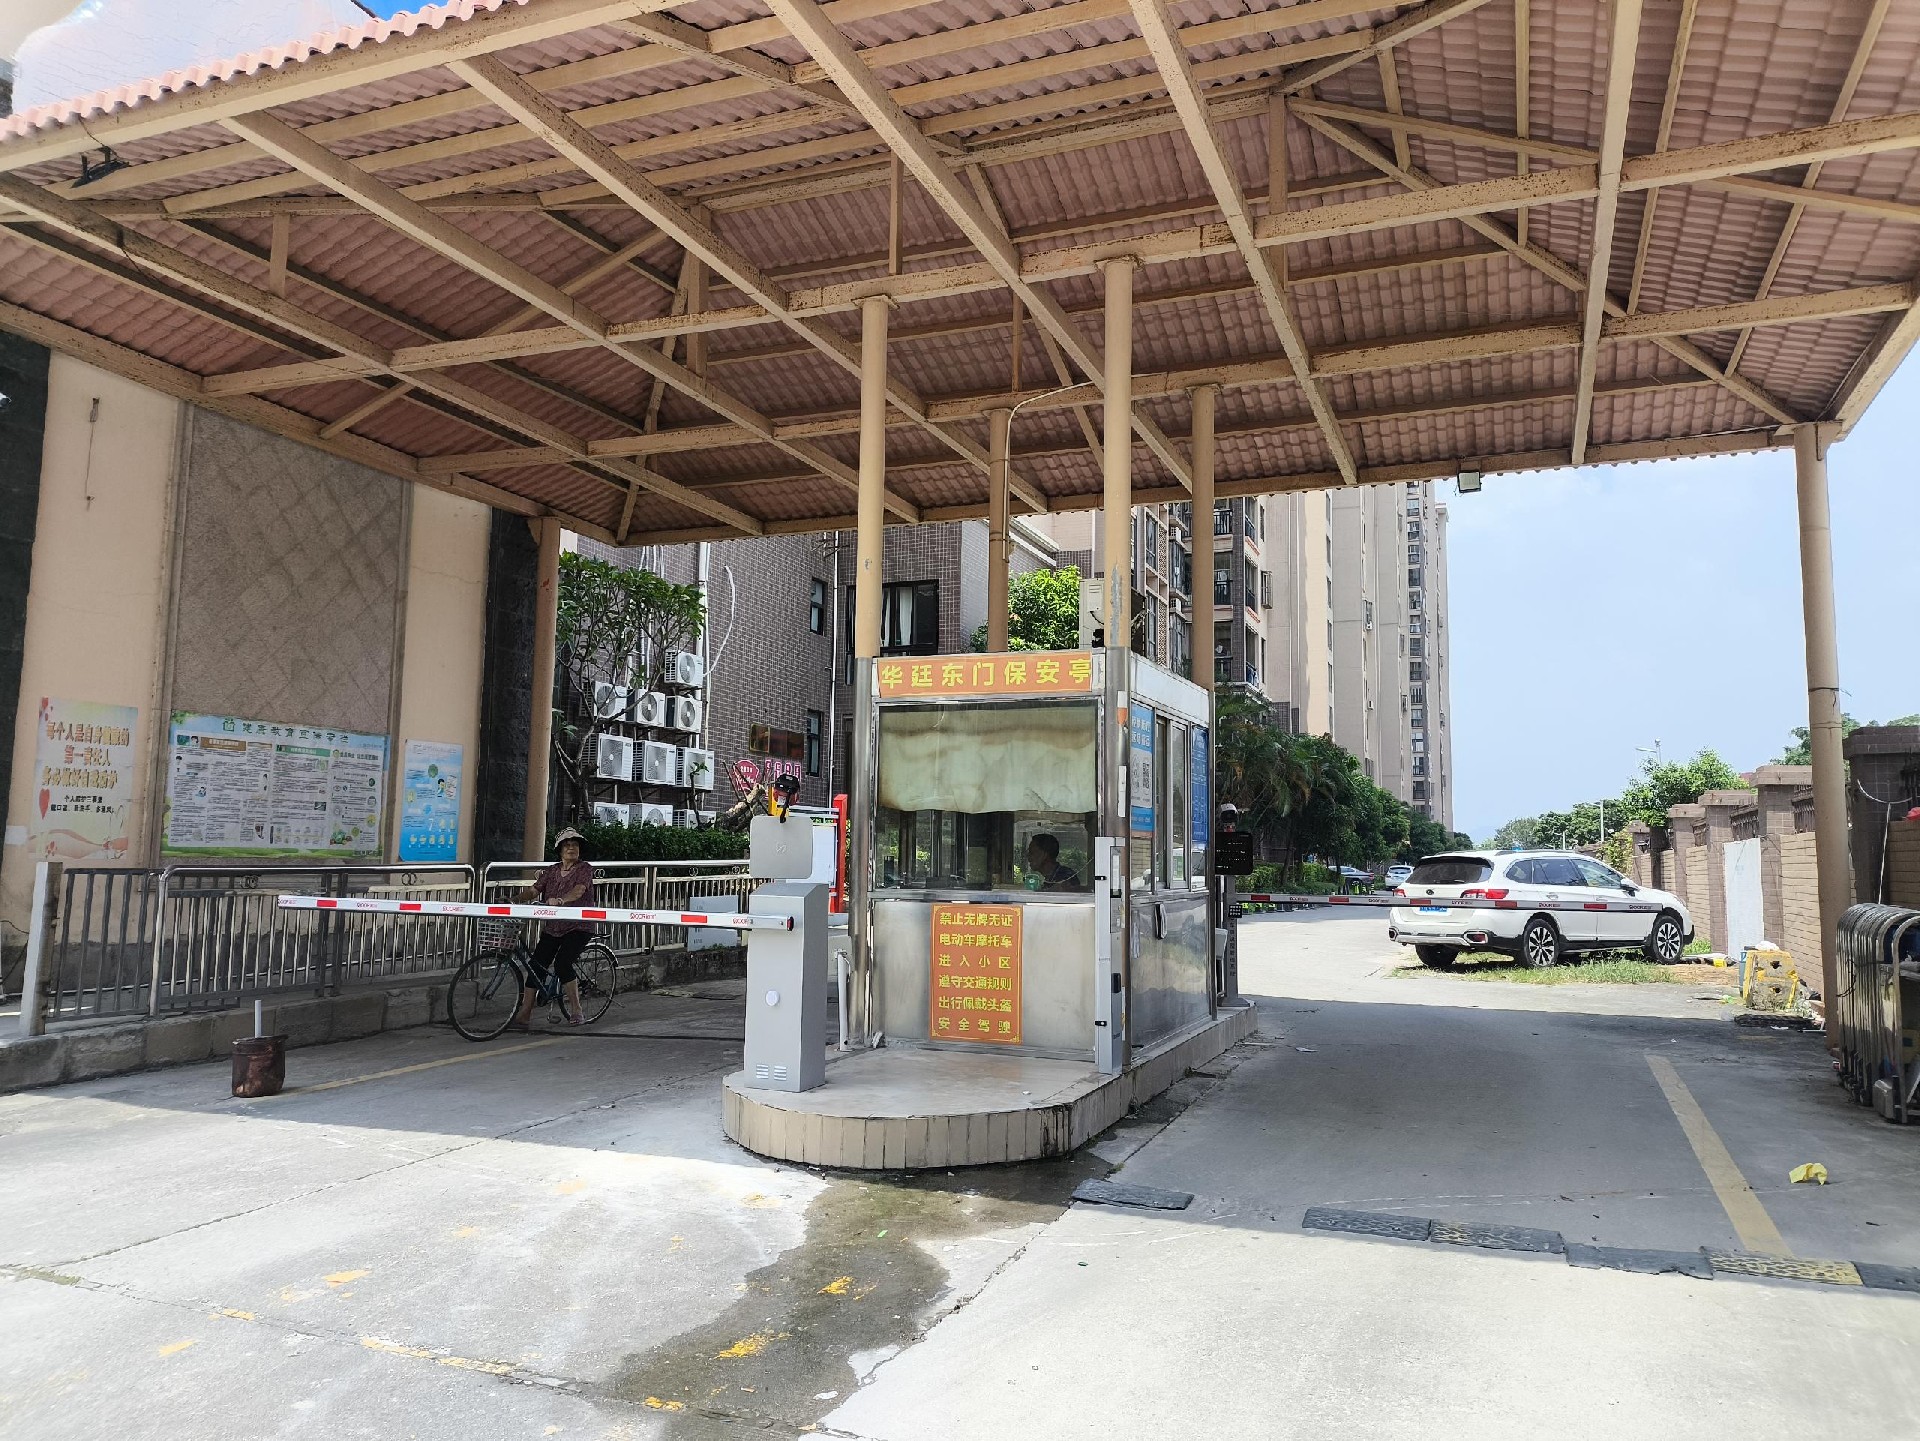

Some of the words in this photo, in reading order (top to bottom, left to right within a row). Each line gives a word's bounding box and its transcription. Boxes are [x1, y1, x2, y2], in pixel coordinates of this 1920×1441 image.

[881, 659, 1091, 689] 华廷东门保安亭
[940, 912, 1013, 927] 禁止无牌无证
[939, 933, 1012, 948] 电动车摩托车
[938, 954, 1011, 969] 进入小区
[938, 975, 1012, 991] 遵守交通规则
[938, 996, 1012, 1012] 出行佩戴头盔
[938, 1017, 1011, 1034] 安全驾驶
